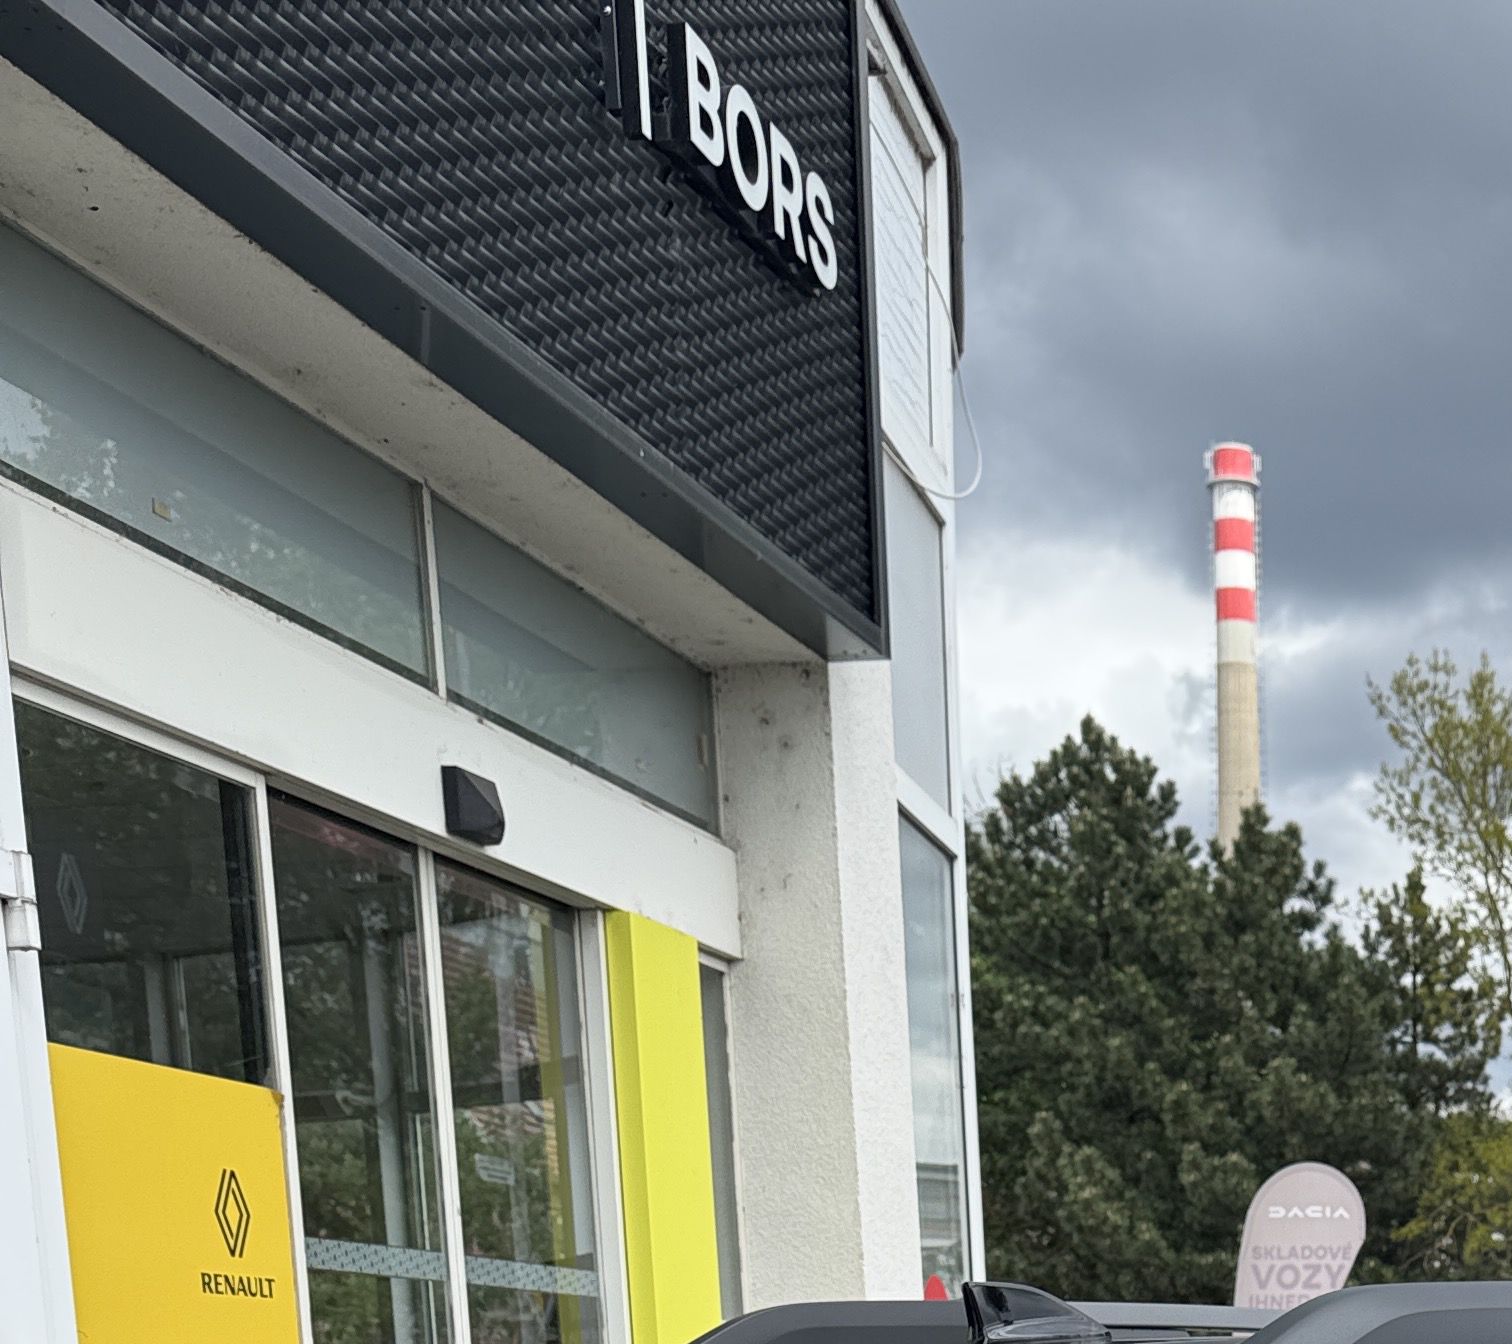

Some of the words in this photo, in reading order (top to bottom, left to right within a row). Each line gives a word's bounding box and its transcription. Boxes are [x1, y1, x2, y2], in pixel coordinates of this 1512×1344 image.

[685, 21, 838, 290] BORS
[1268, 1205, 1350, 1219] DACIA
[1251, 1242, 1353, 1260] SKLADOVÉ
[200, 1271, 276, 1299] RENAULT
[1250, 1263, 1346, 1290] VOZY
